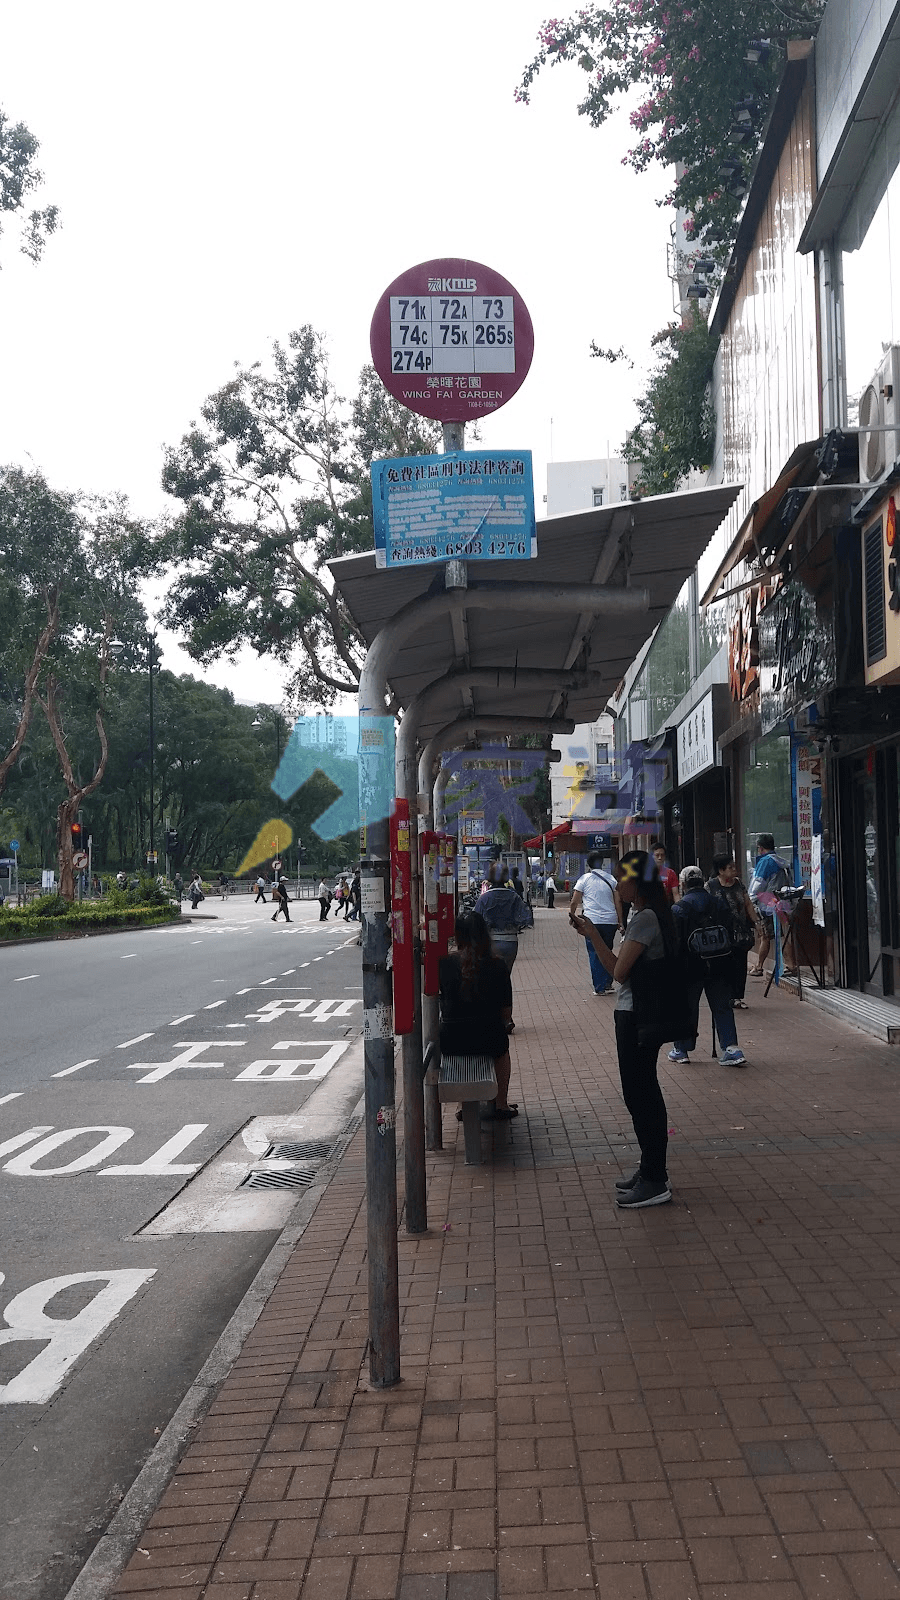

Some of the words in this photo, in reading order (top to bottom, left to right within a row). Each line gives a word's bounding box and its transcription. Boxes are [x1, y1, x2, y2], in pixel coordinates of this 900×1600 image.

[398, 299, 426, 320] 71K
[439, 299, 468, 320] 72A
[482, 299, 504, 319] 73
[399, 325, 428, 345] 74C
[439, 325, 468, 345] 75K
[475, 325, 513, 345] 265S
[393, 351, 432, 371] 274P
[426, 376, 482, 389] 榮暉花園
[402, 390, 431, 399] WING
[436, 390, 453, 399] FAI
[458, 390, 503, 399] GARDEN
[445, 542, 483, 555] 6803
[487, 541, 526, 555] 4276
[126, 1040, 353, 1084] 巴士
